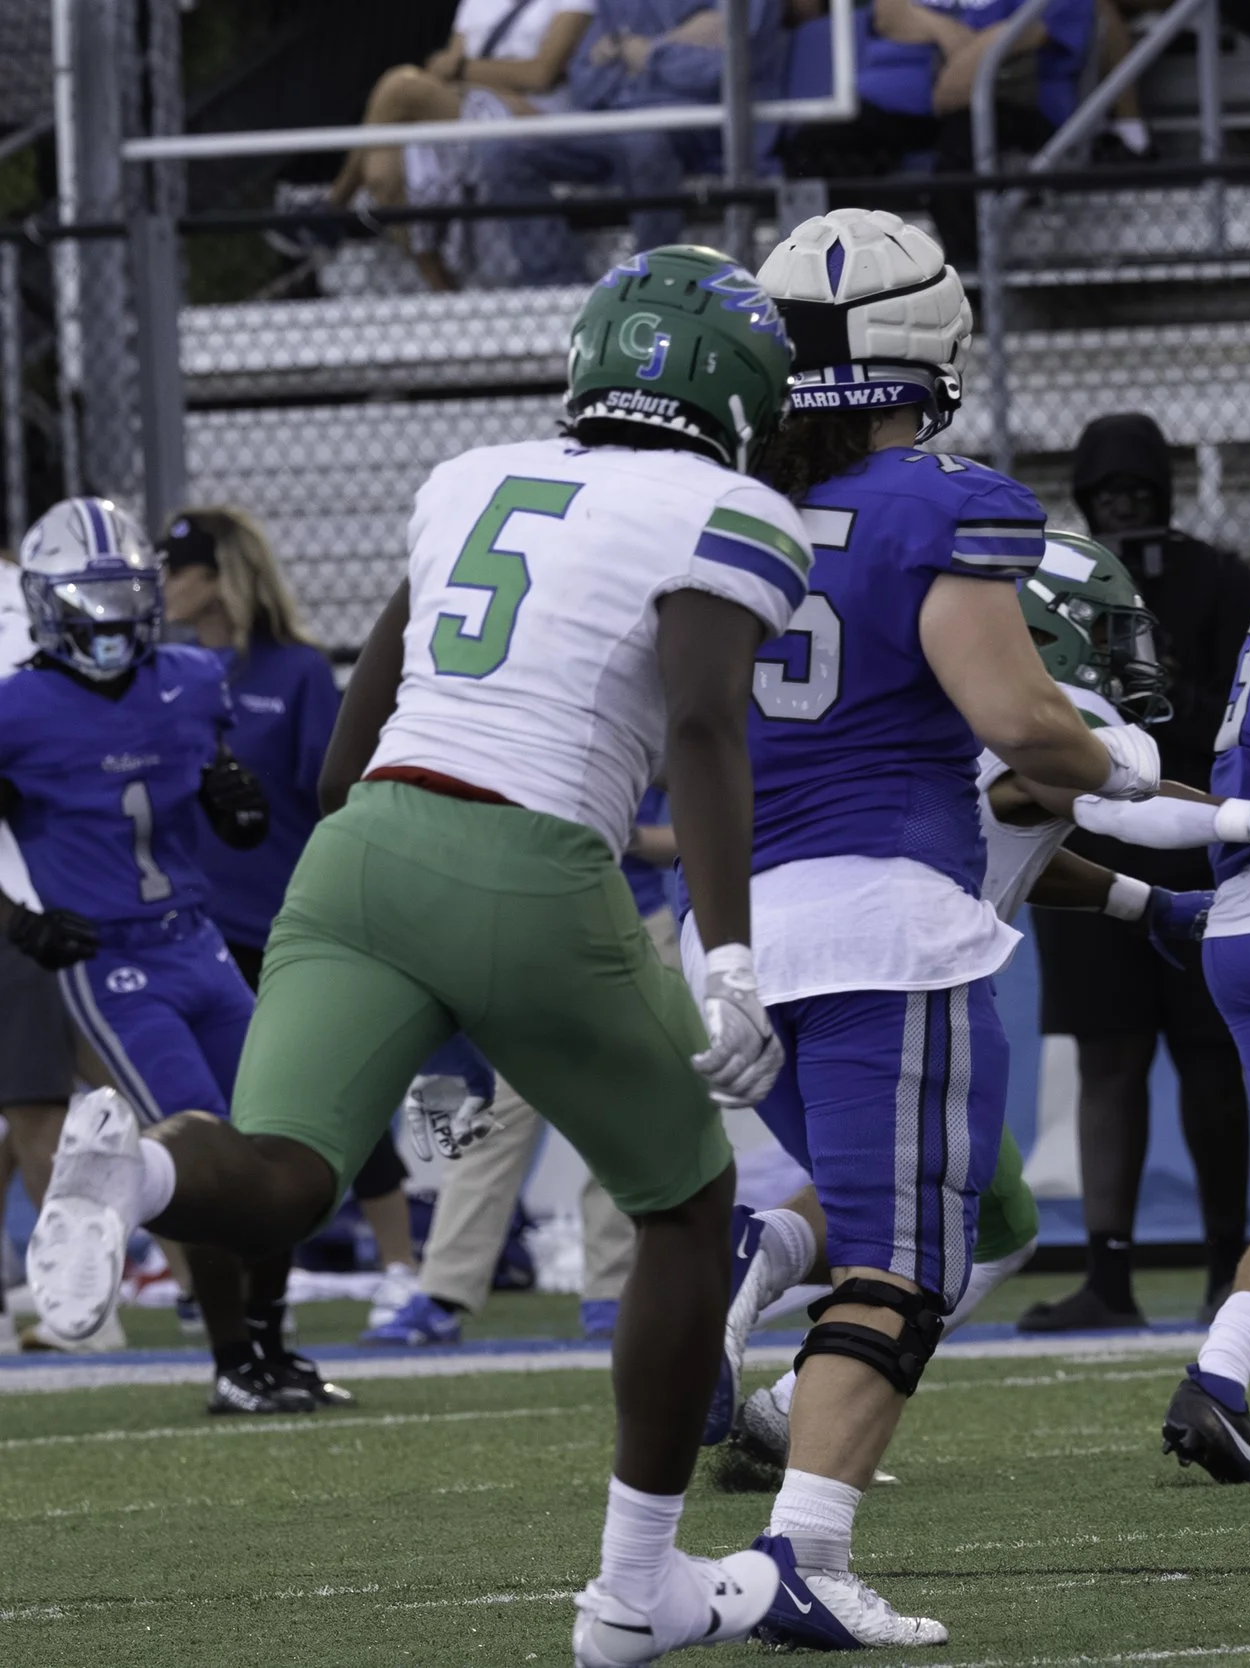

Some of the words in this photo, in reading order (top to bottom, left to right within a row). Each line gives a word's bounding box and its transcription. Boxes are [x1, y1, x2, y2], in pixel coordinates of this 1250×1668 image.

[606, 389, 681, 417] schutt
[791, 391, 841, 409] HARD
[844, 385, 904, 405] WAY
[429, 474, 586, 680] 5
[120, 778, 172, 904] 1
